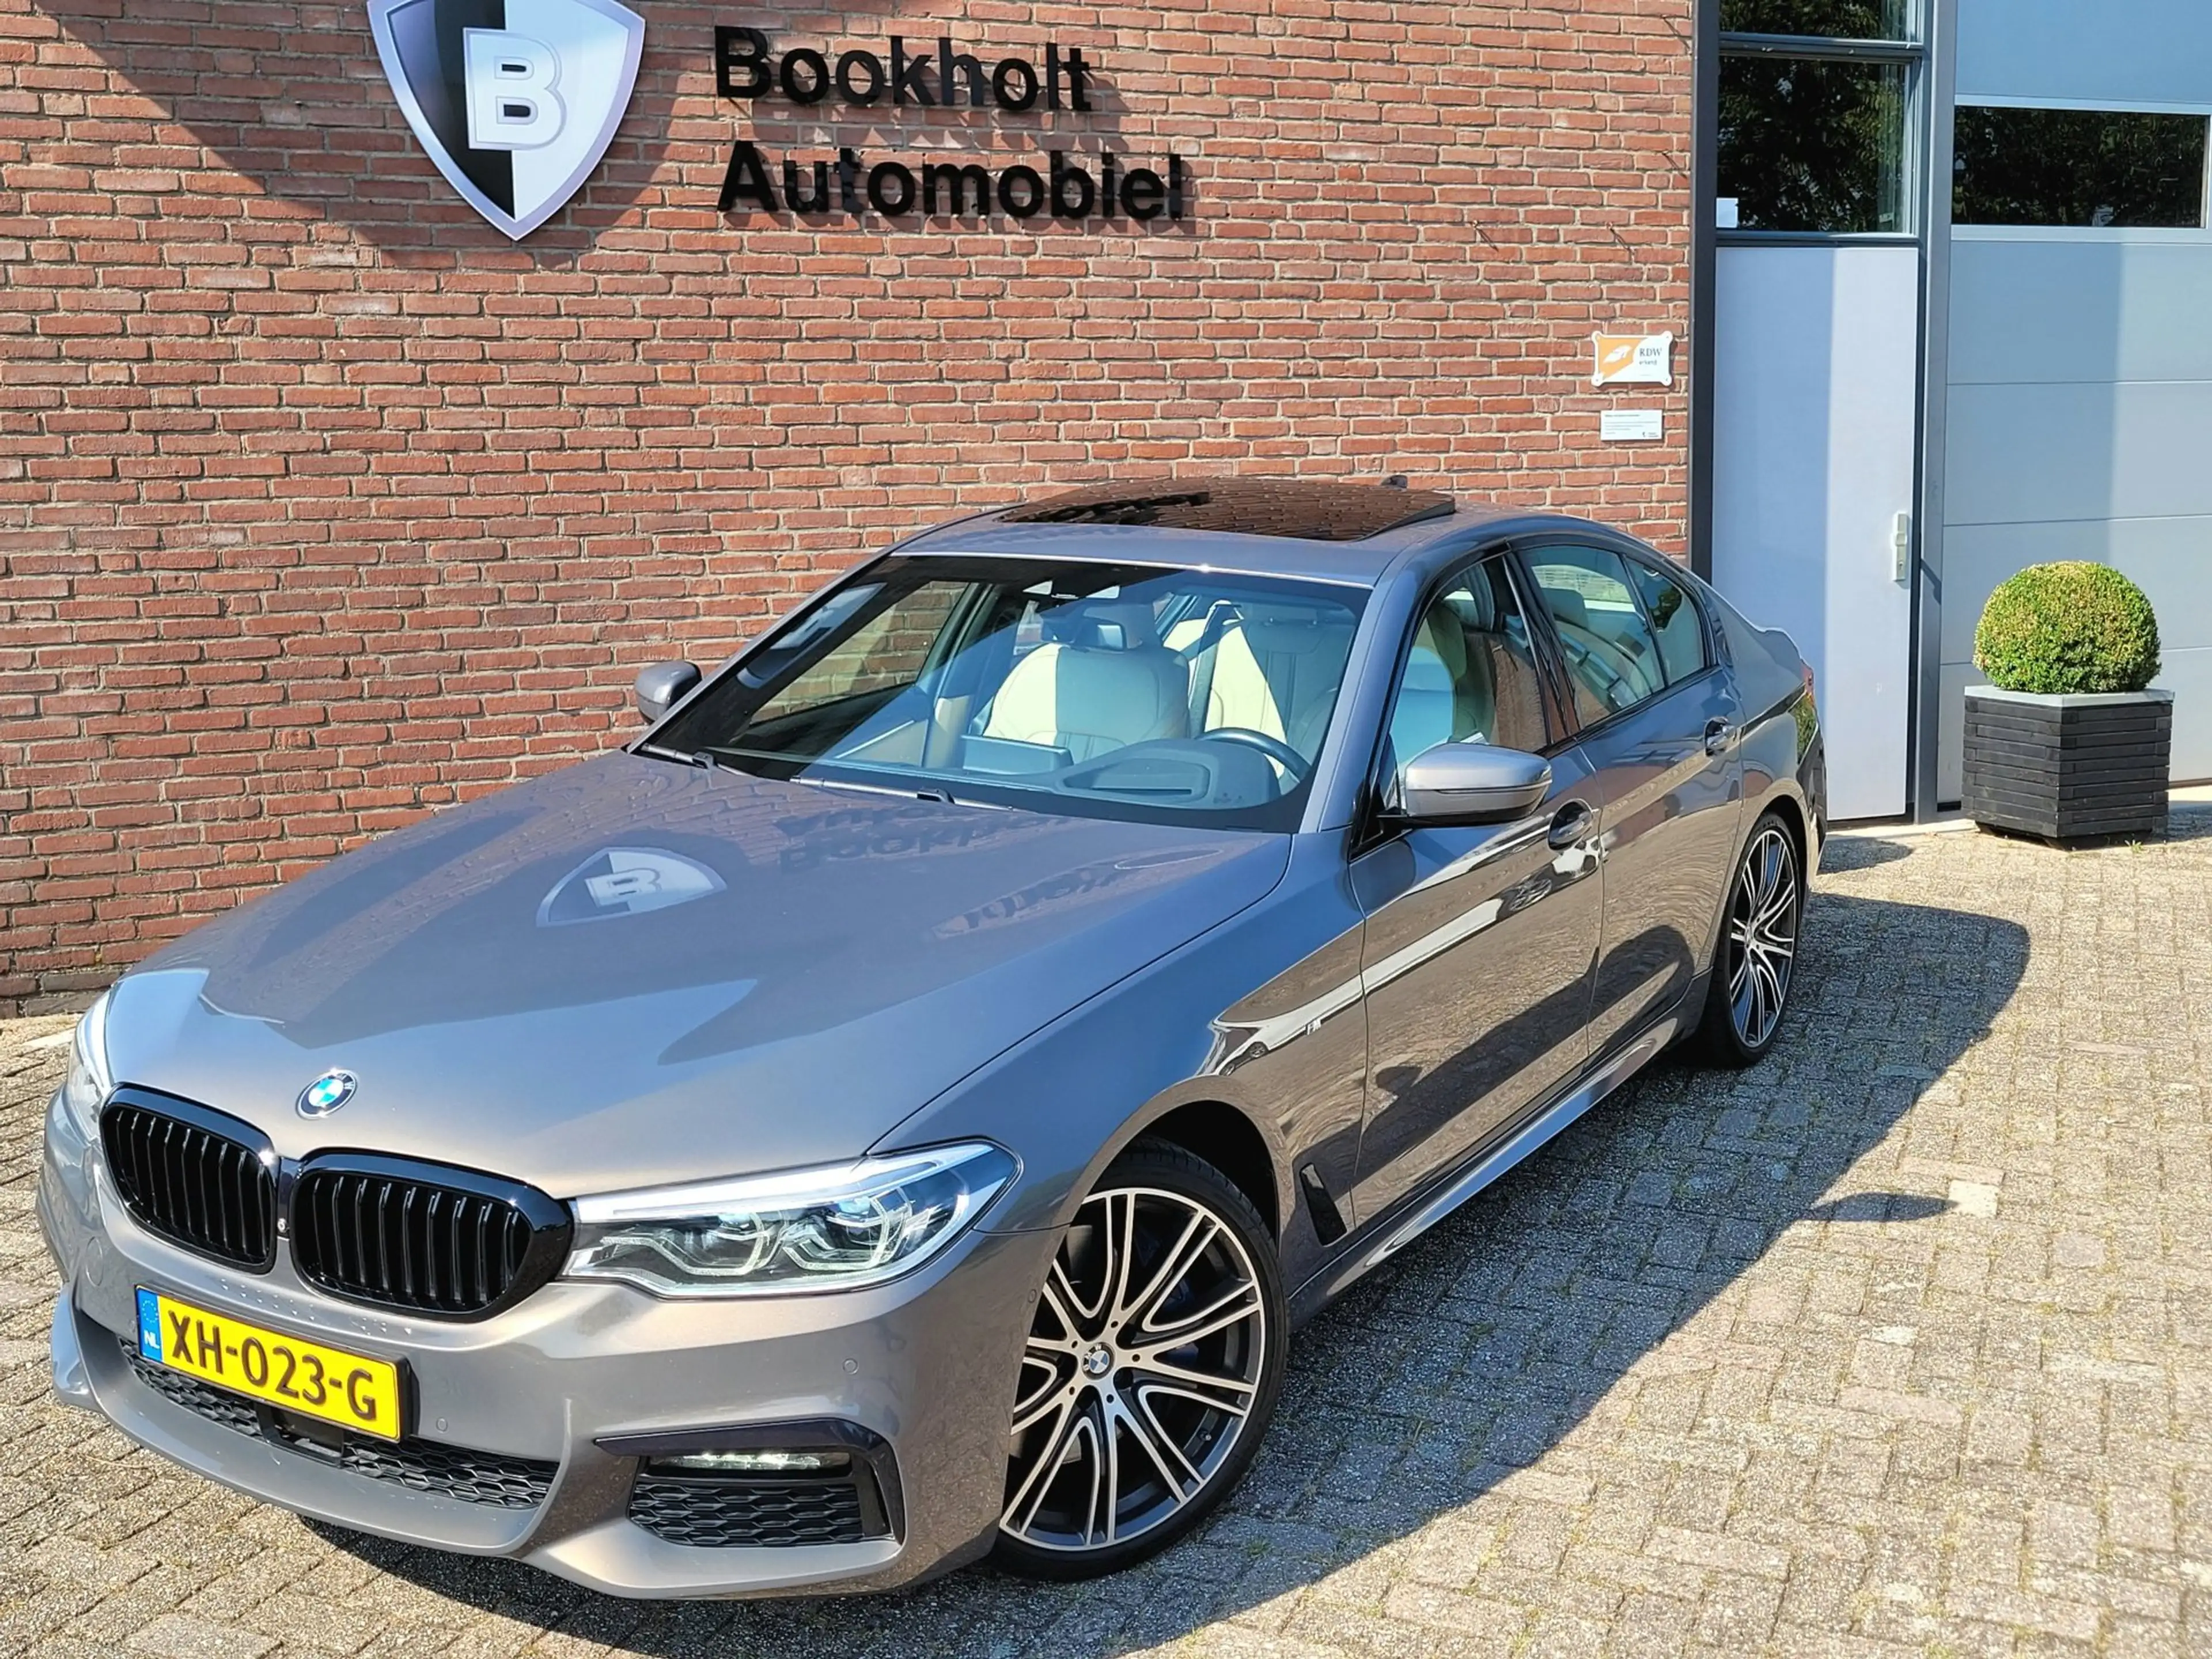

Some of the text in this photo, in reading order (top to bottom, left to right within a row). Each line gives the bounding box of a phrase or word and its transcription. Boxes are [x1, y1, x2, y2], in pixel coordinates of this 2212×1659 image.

[462, 26, 568, 151] B
[715, 26, 1093, 112] Bookholt
[717, 141, 1182, 221] Automobiel
[1639, 347, 1662, 357] RDW
[144, 1329, 160, 1349] NL
[168, 1310, 377, 1422] XH-023-G
